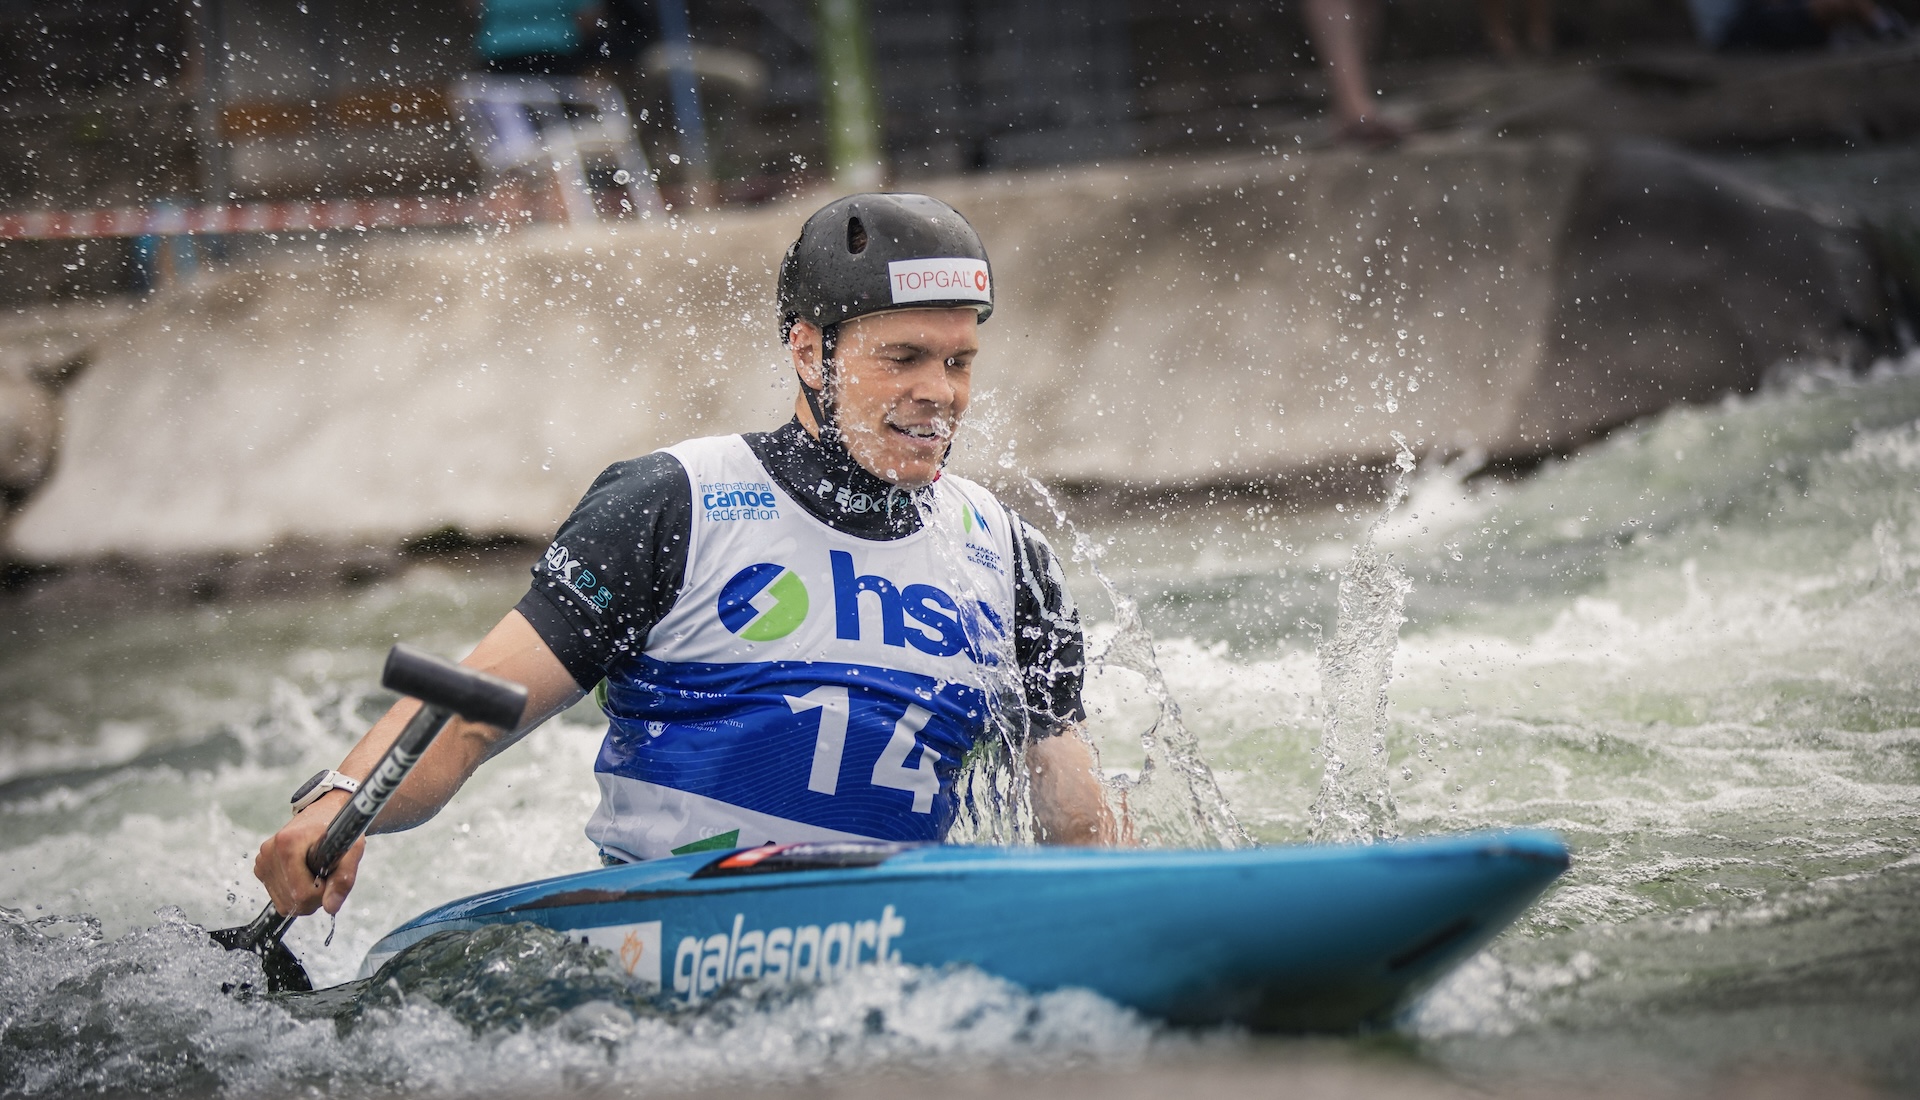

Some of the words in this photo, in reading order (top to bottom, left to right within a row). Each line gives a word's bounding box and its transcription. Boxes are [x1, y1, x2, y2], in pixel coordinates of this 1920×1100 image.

[700, 481, 772, 493] international
[703, 490, 776, 510] canoe
[706, 508, 780, 522] federation
[544, 541, 581, 580] EAK
[556, 573, 603, 615] pddlesports
[783, 685, 942, 814] 14
[672, 904, 906, 1003] galasport
